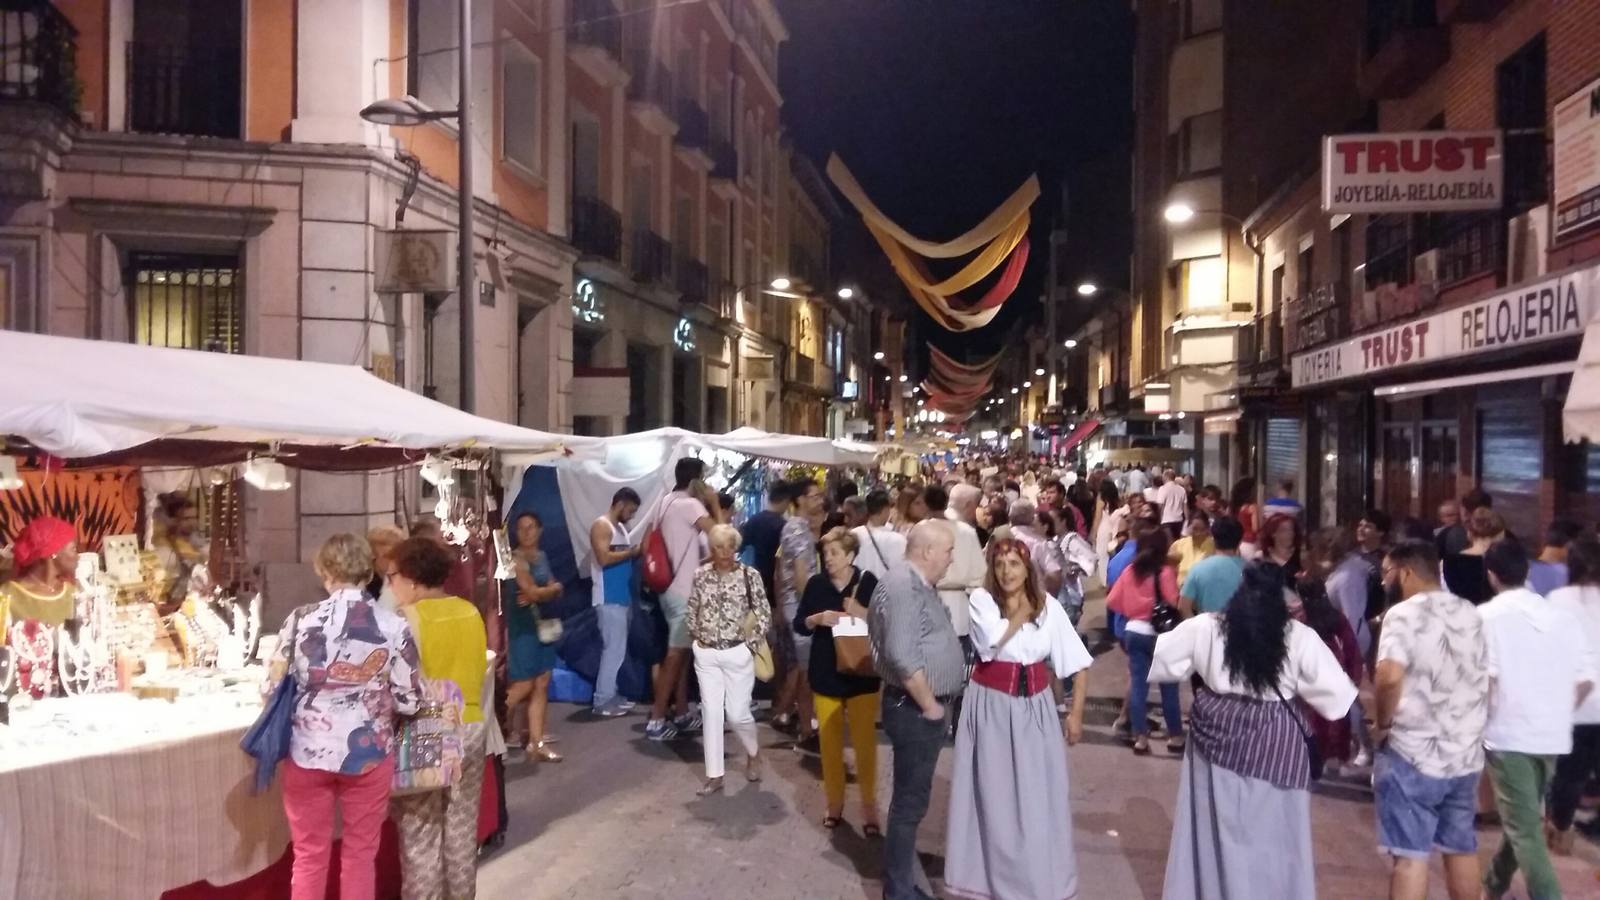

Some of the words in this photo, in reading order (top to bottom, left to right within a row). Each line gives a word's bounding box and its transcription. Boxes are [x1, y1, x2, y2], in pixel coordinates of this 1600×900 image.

[1336, 137, 1495, 174] TRUST
[1335, 178, 1495, 203] JOYERÍA-RELOJERÍA
[1300, 347, 1342, 384] JOYERIA
[1361, 322, 1429, 370] TRUST
